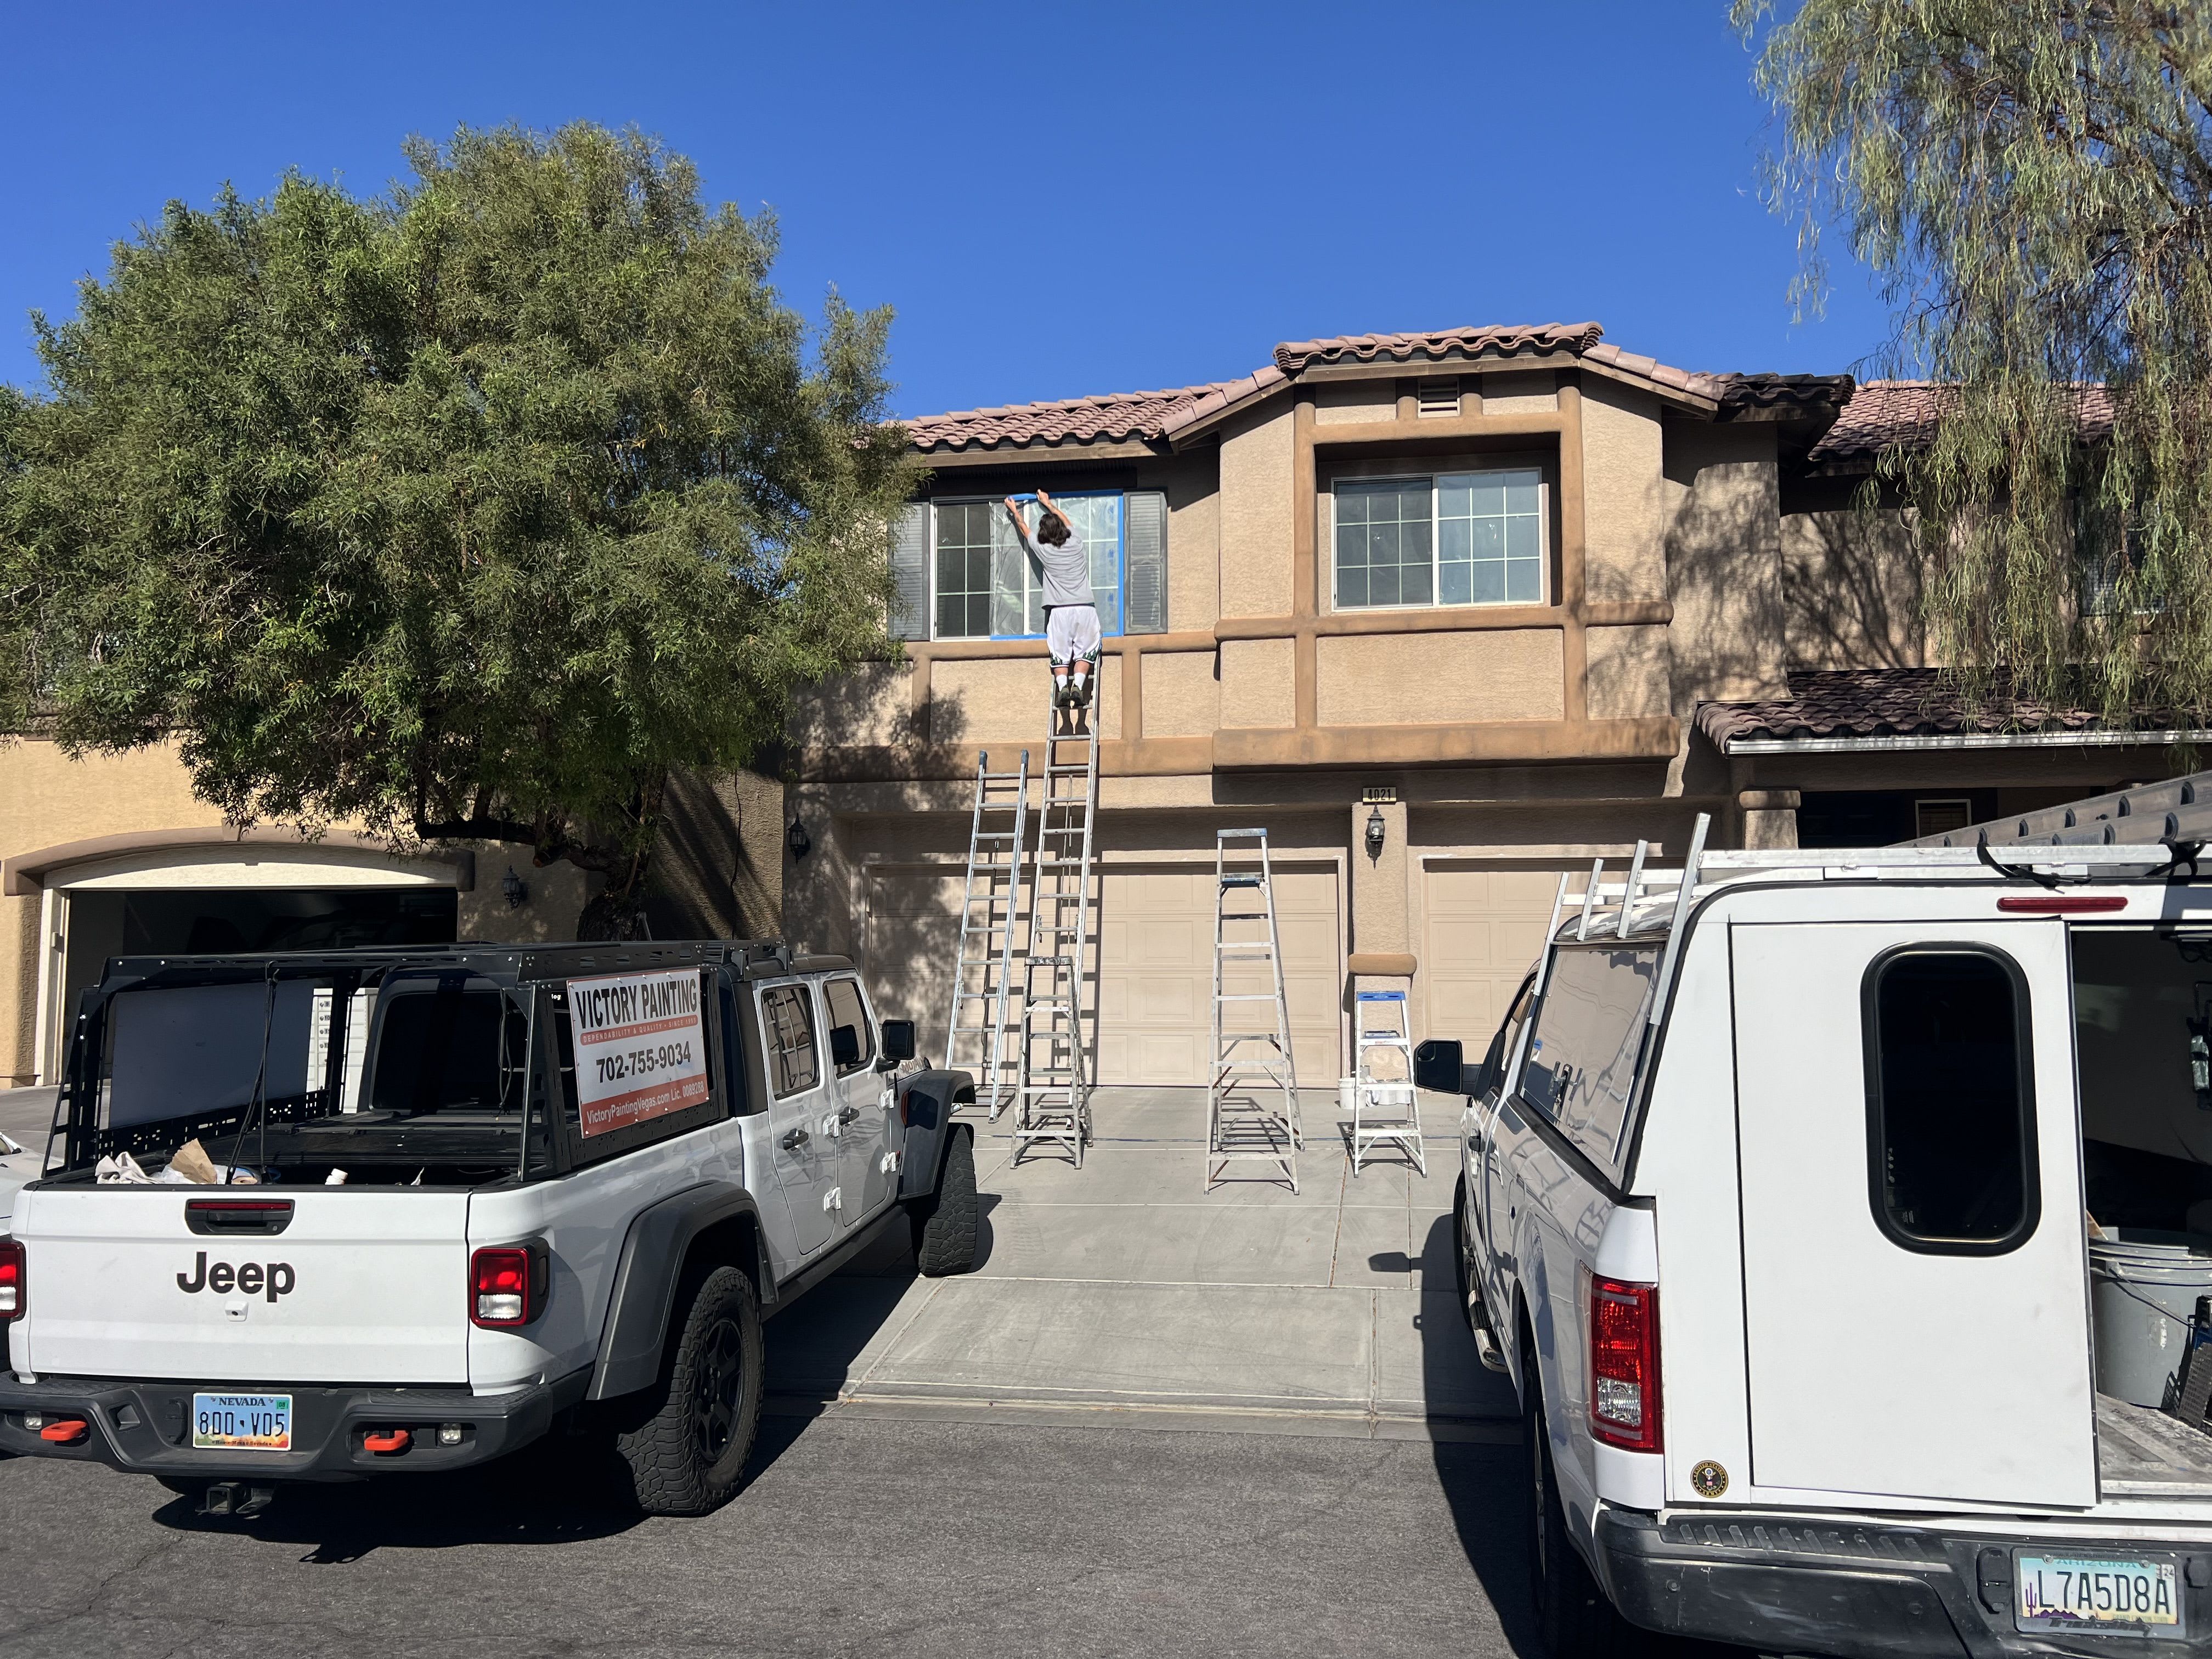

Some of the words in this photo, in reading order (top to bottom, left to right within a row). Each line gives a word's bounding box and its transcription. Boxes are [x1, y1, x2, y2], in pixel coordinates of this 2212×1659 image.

[1368, 788, 1391, 800] 4021
[575, 985, 637, 1029] VICTORY
[641, 978, 697, 1019] PAINTING
[583, 1029, 630, 1042] DEPENDABILITY
[639, 1023, 662, 1033] QUALITY
[668, 1019, 684, 1028] SINCE
[596, 1041, 691, 1083] 702-755-9034
[586, 1092, 670, 1124] VictoryPaintingVegas.com
[670, 1088, 681, 1101] Lic.
[177, 1251, 295, 1302] Jeep
[218, 1398, 266, 1406] NEVADA
[2057, 1559, 2136, 1568] ARIZONA
[2038, 1570, 2170, 1615] L7A5D8A
